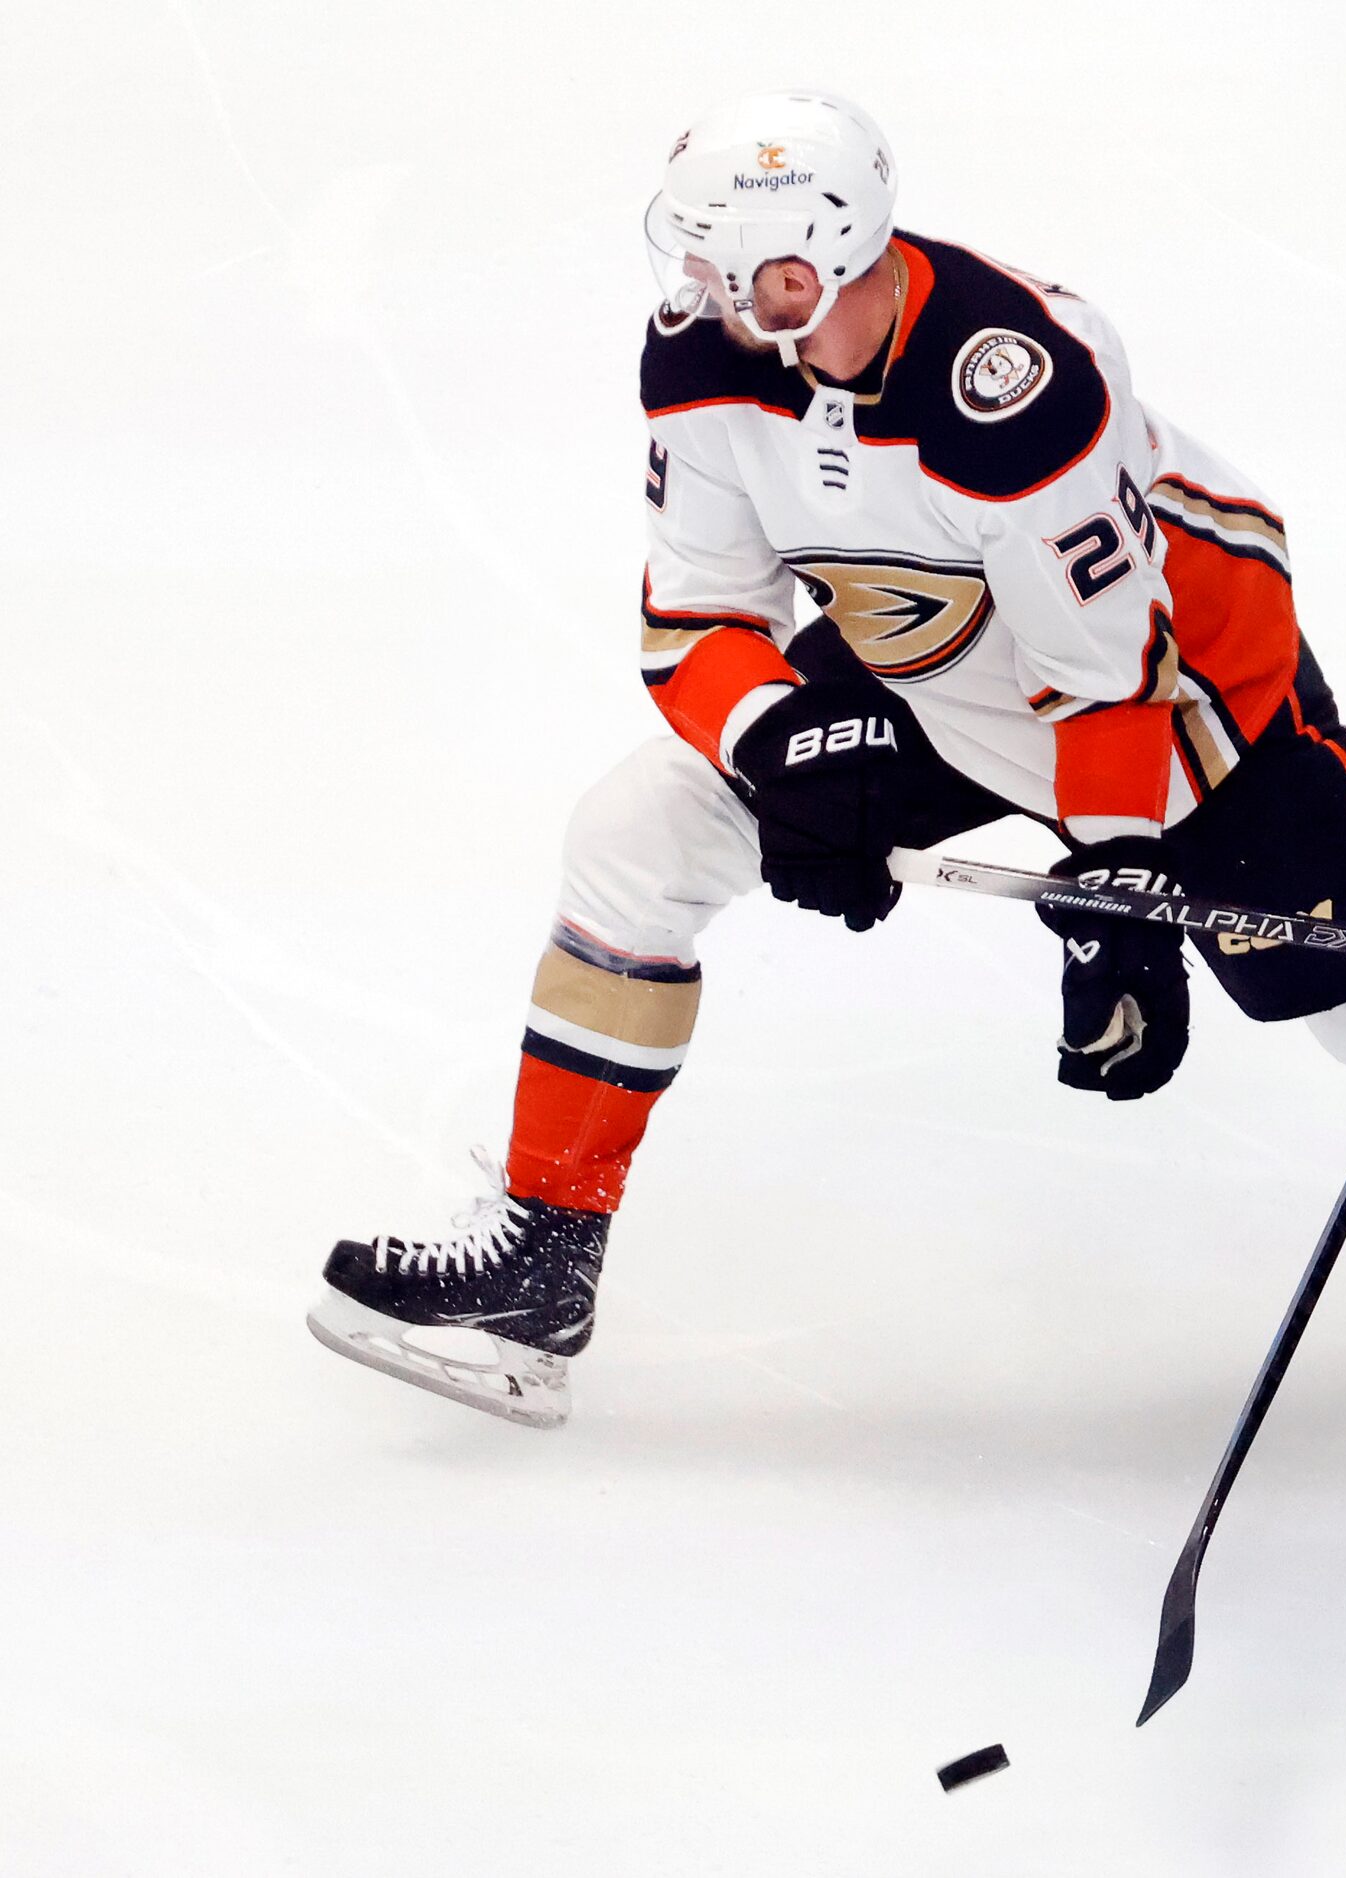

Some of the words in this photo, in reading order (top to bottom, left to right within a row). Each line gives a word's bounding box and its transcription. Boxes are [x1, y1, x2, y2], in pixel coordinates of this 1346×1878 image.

[733, 169, 815, 192] Navigator
[998, 364, 1040, 405] DUCKS
[1038, 460, 1157, 608] 29
[785, 716, 898, 766] BAU
[1040, 891, 1132, 914] WARRIOR
[1146, 902, 1294, 942] ALPHA
